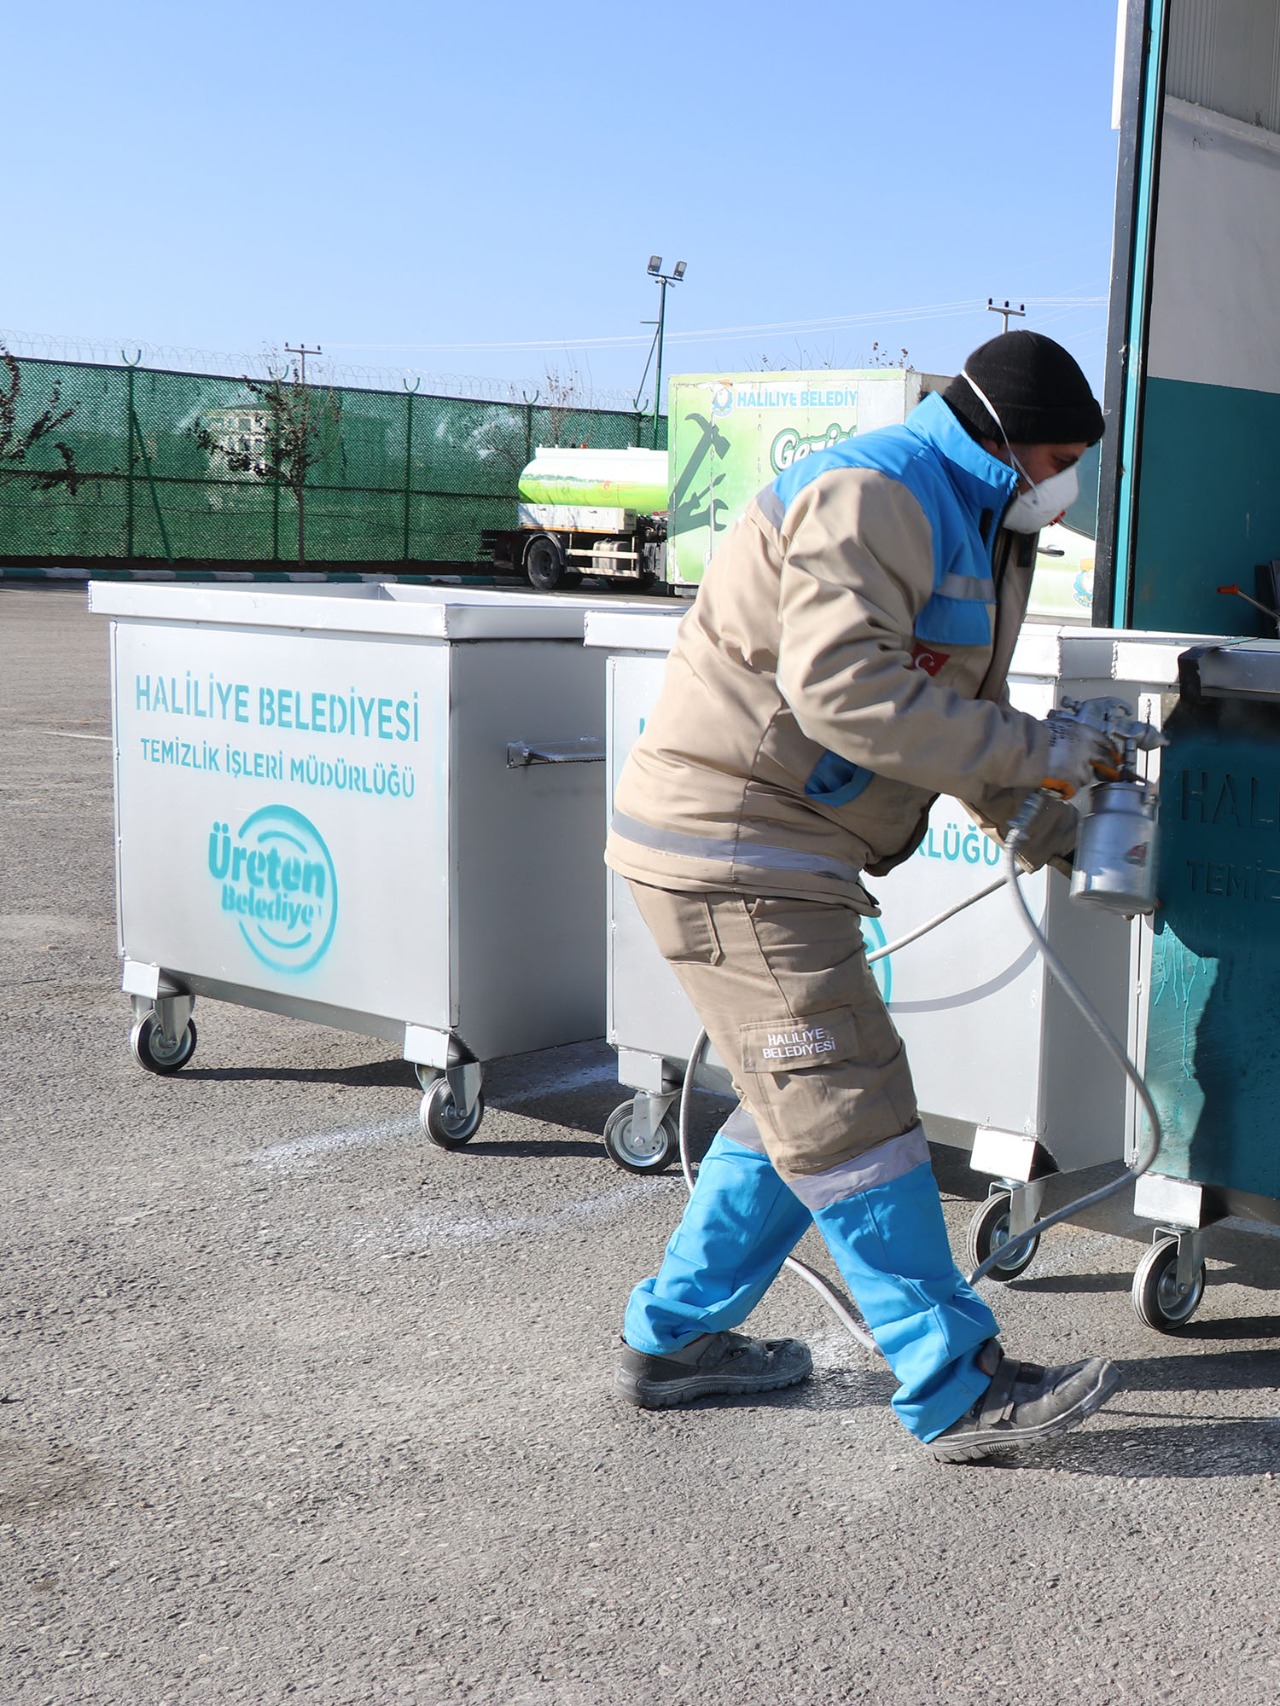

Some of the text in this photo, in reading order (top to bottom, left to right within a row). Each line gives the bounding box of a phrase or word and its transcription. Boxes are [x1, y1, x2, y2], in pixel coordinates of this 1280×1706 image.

[135, 670, 419, 743] HALİLİYE BELEDİYESİ
[140, 736, 416, 798] TEMİZLİK İŞLERİ MÜDÜRLÜĞÜ
[208, 821, 326, 899] Üreten
[762, 1037, 837, 1059] BELEDİYESİ
[768, 1027, 826, 1047] HALİLİYE
